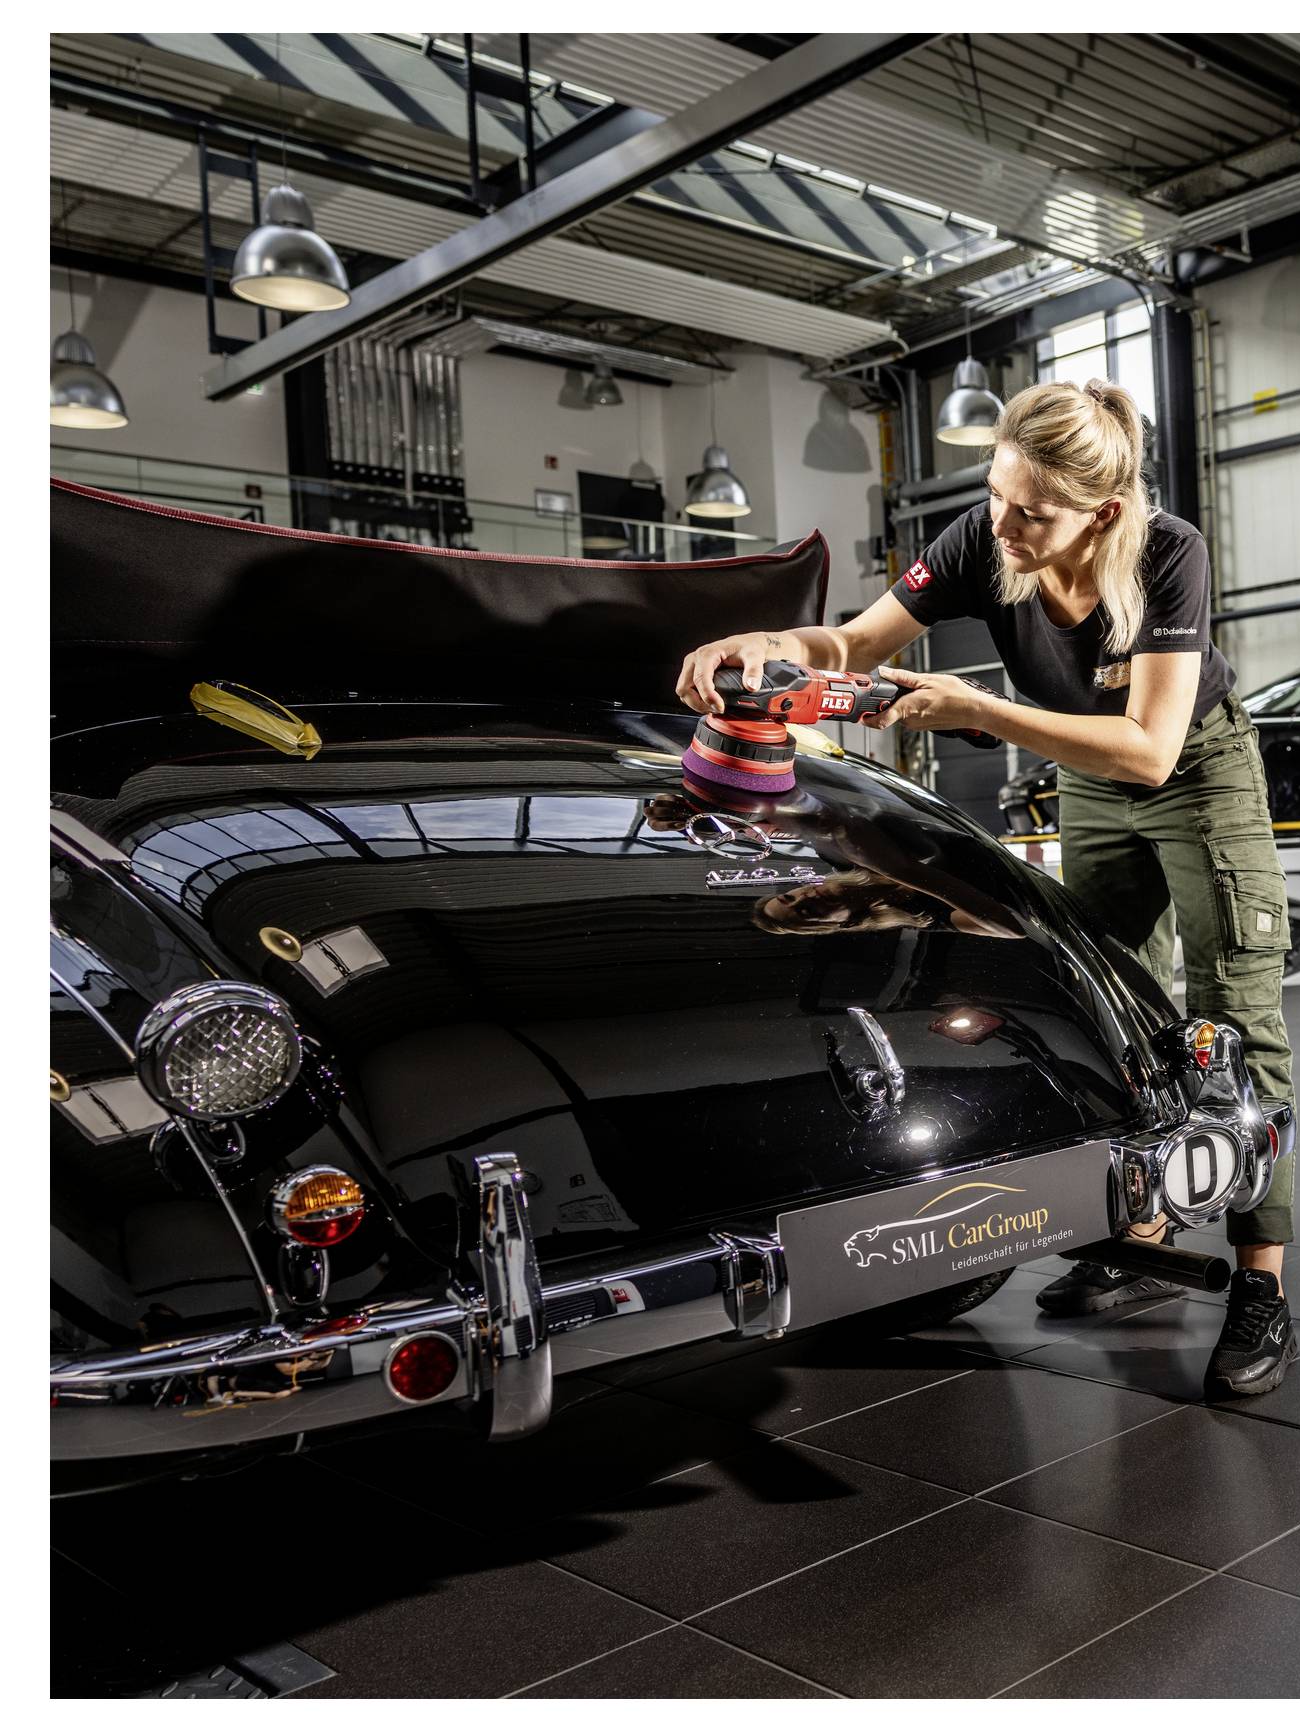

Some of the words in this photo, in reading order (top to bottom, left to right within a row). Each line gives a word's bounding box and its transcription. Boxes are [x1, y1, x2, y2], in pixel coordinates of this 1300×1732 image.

[910, 562, 931, 585] EX
[821, 697, 851, 710] FLEX
[1184, 1134, 1218, 1207] D
[892, 1230, 944, 1265] SML
[948, 1207, 1049, 1249] CarGroup
[951, 1245, 1013, 1271] Leidenschaft
[1015, 1240, 1029, 1252] für
[1032, 1228, 1073, 1248] Legenden
